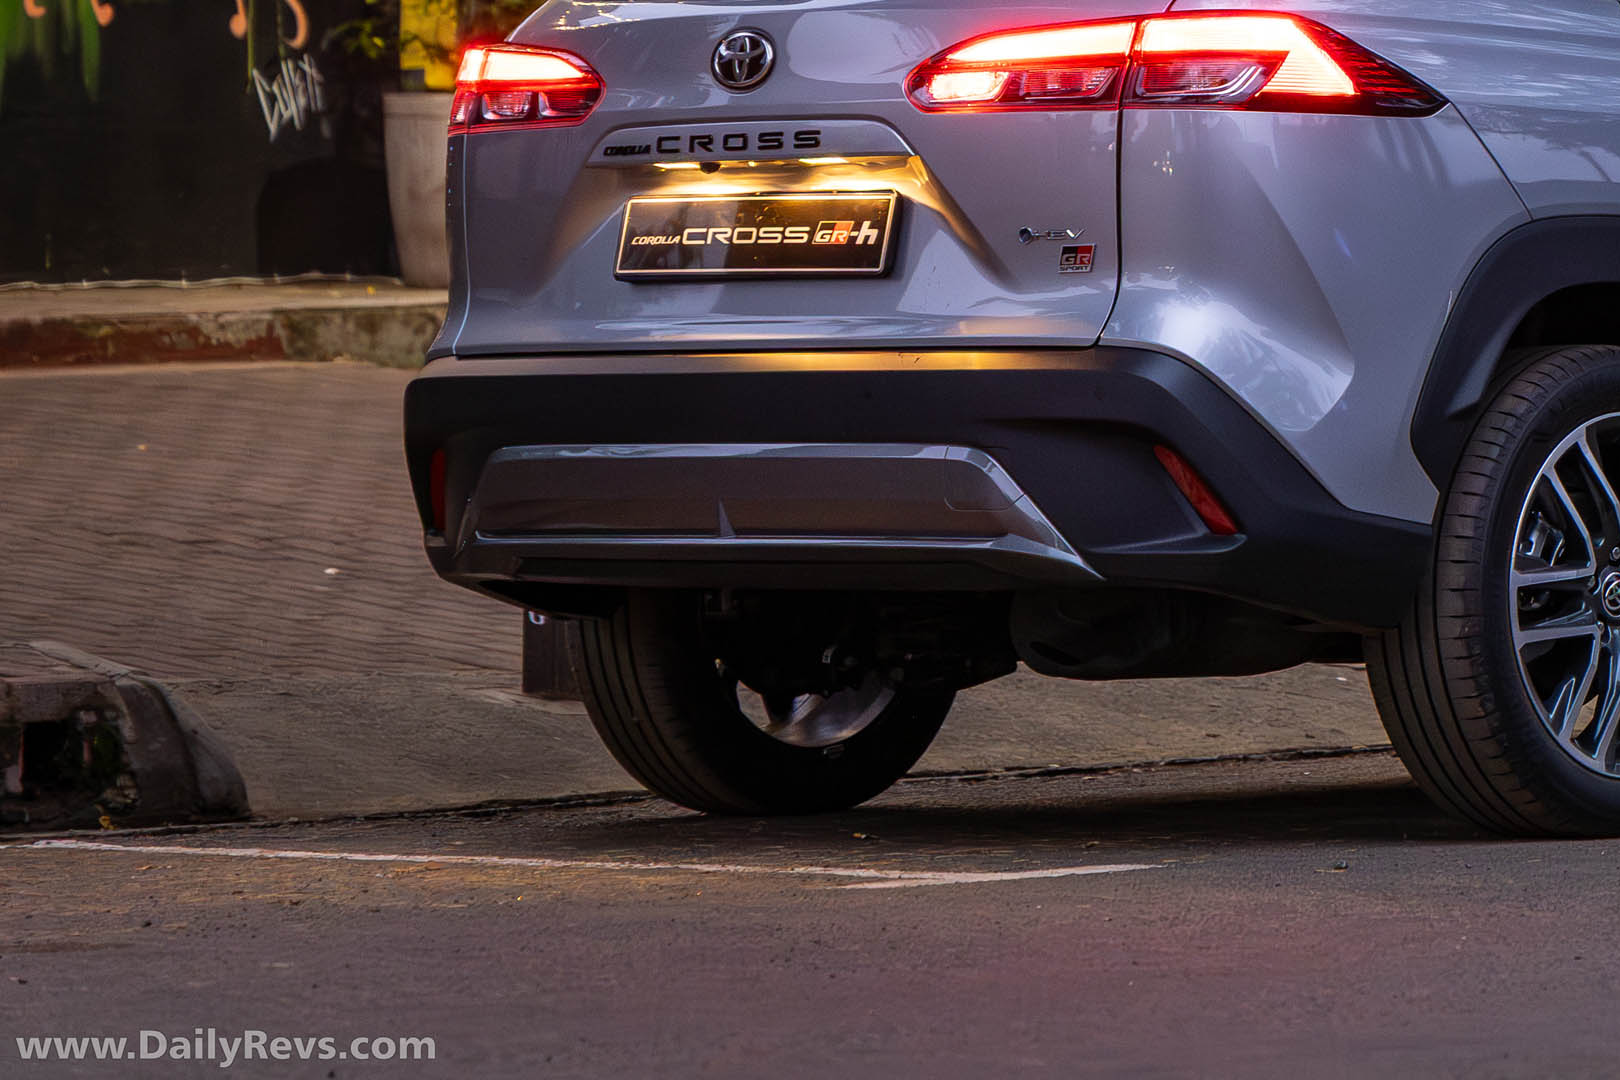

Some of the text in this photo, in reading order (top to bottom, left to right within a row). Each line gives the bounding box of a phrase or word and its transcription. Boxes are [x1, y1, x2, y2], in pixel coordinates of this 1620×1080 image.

[656, 130, 821, 154] CROSS
[631, 235, 682, 245] COROLLA
[682, 226, 811, 245] CROSS
[1061, 253, 1092, 265] GR
